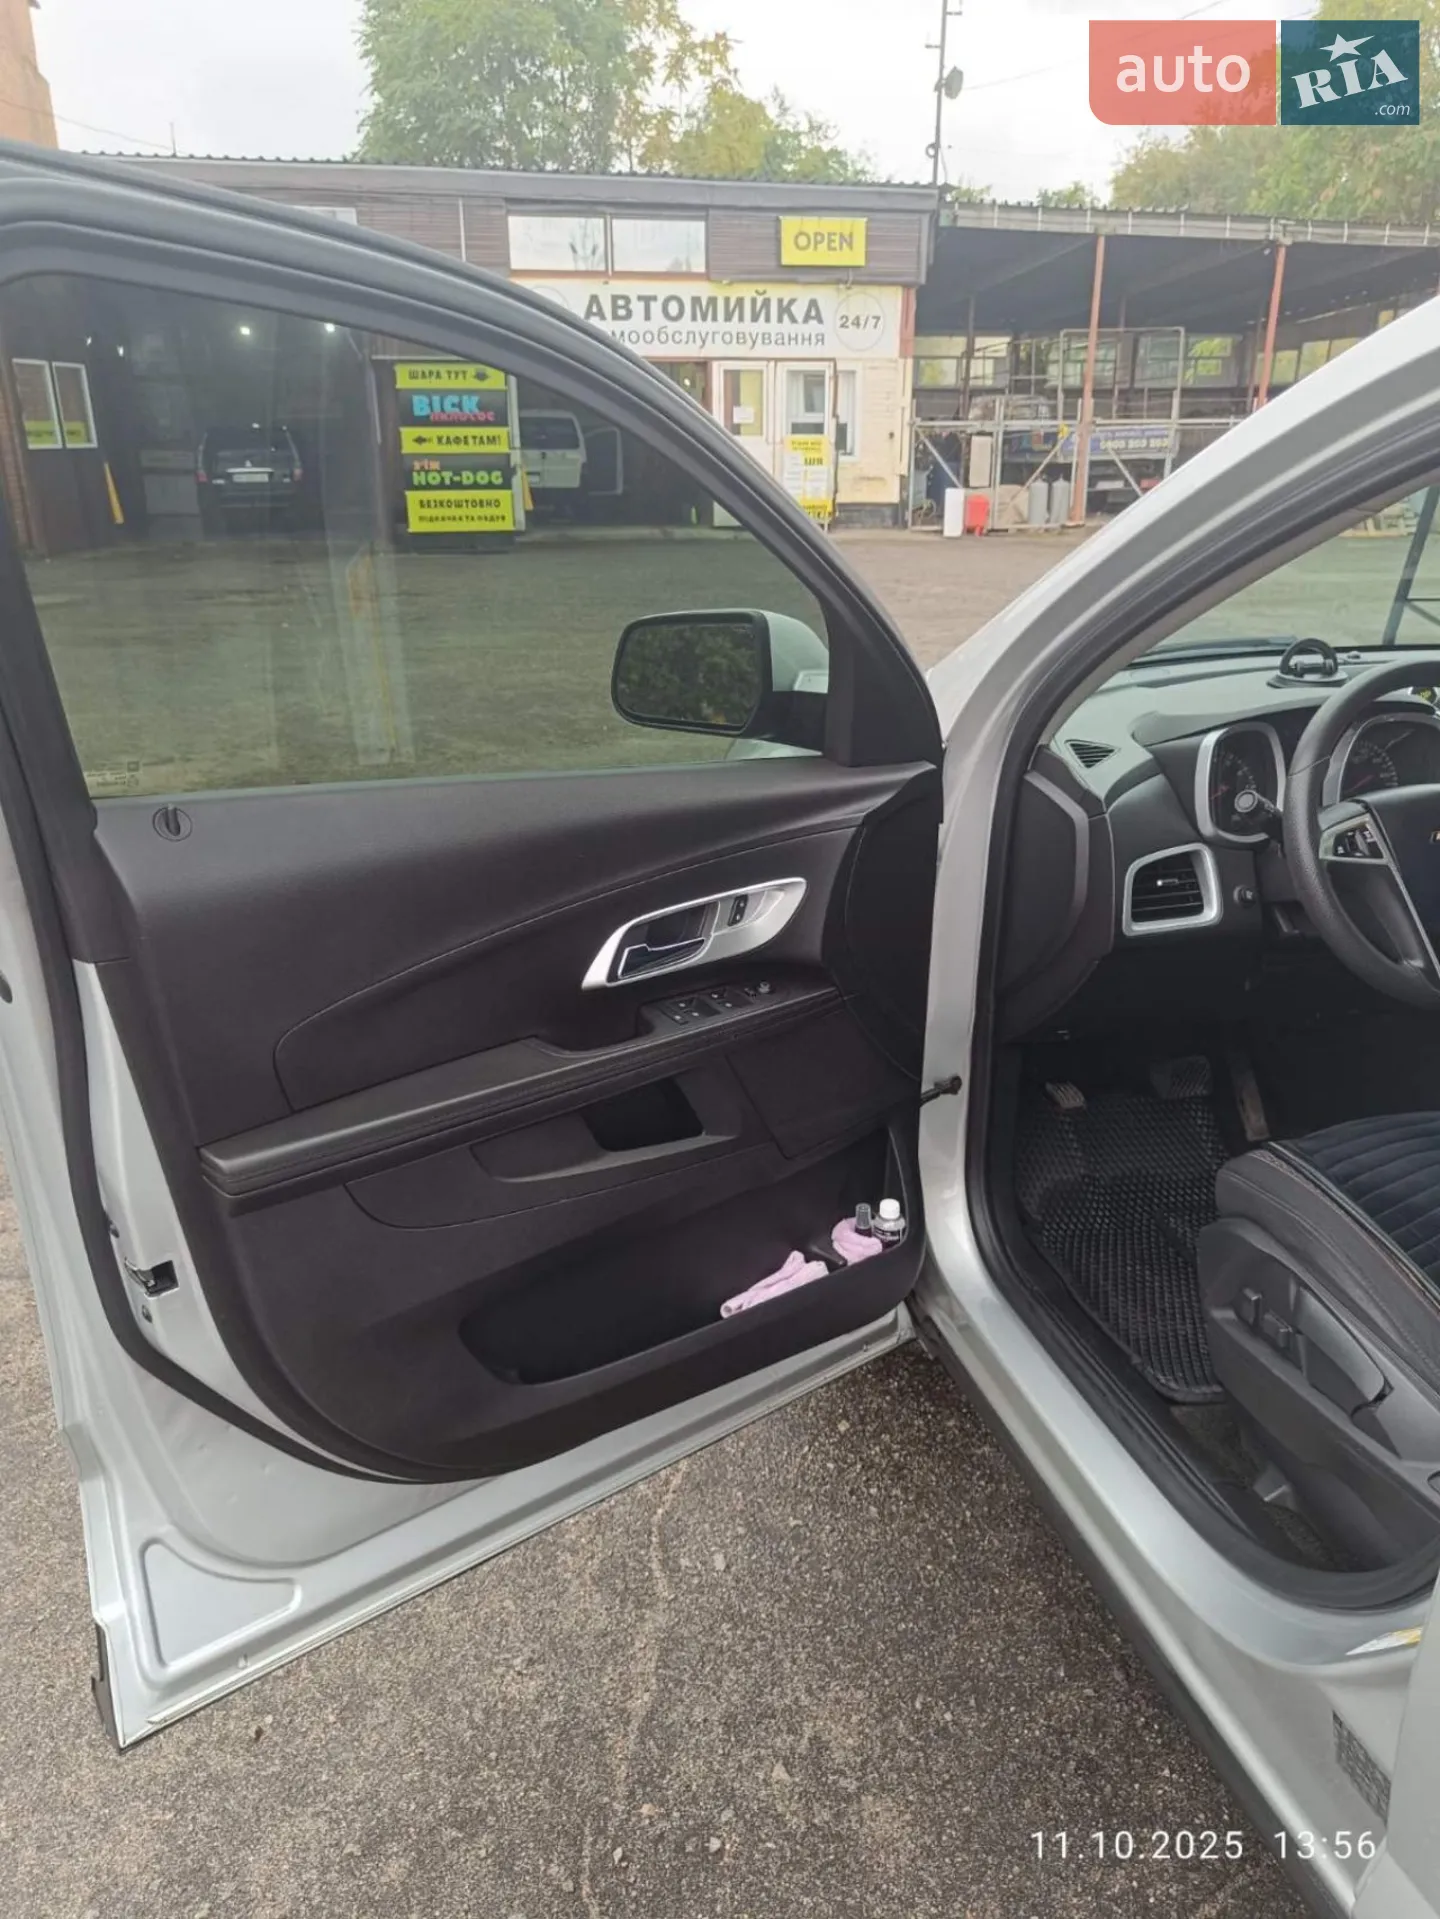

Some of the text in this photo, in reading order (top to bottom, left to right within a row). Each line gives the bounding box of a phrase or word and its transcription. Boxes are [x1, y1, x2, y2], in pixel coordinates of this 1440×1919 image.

[793, 231, 854, 252] OPEN
[584, 288, 825, 325] АВТОМИЙКА
[838, 314, 881, 331] 24/7
[611, 326, 826, 350] мообслуговування
[412, 470, 503, 486] HOT-DOG
